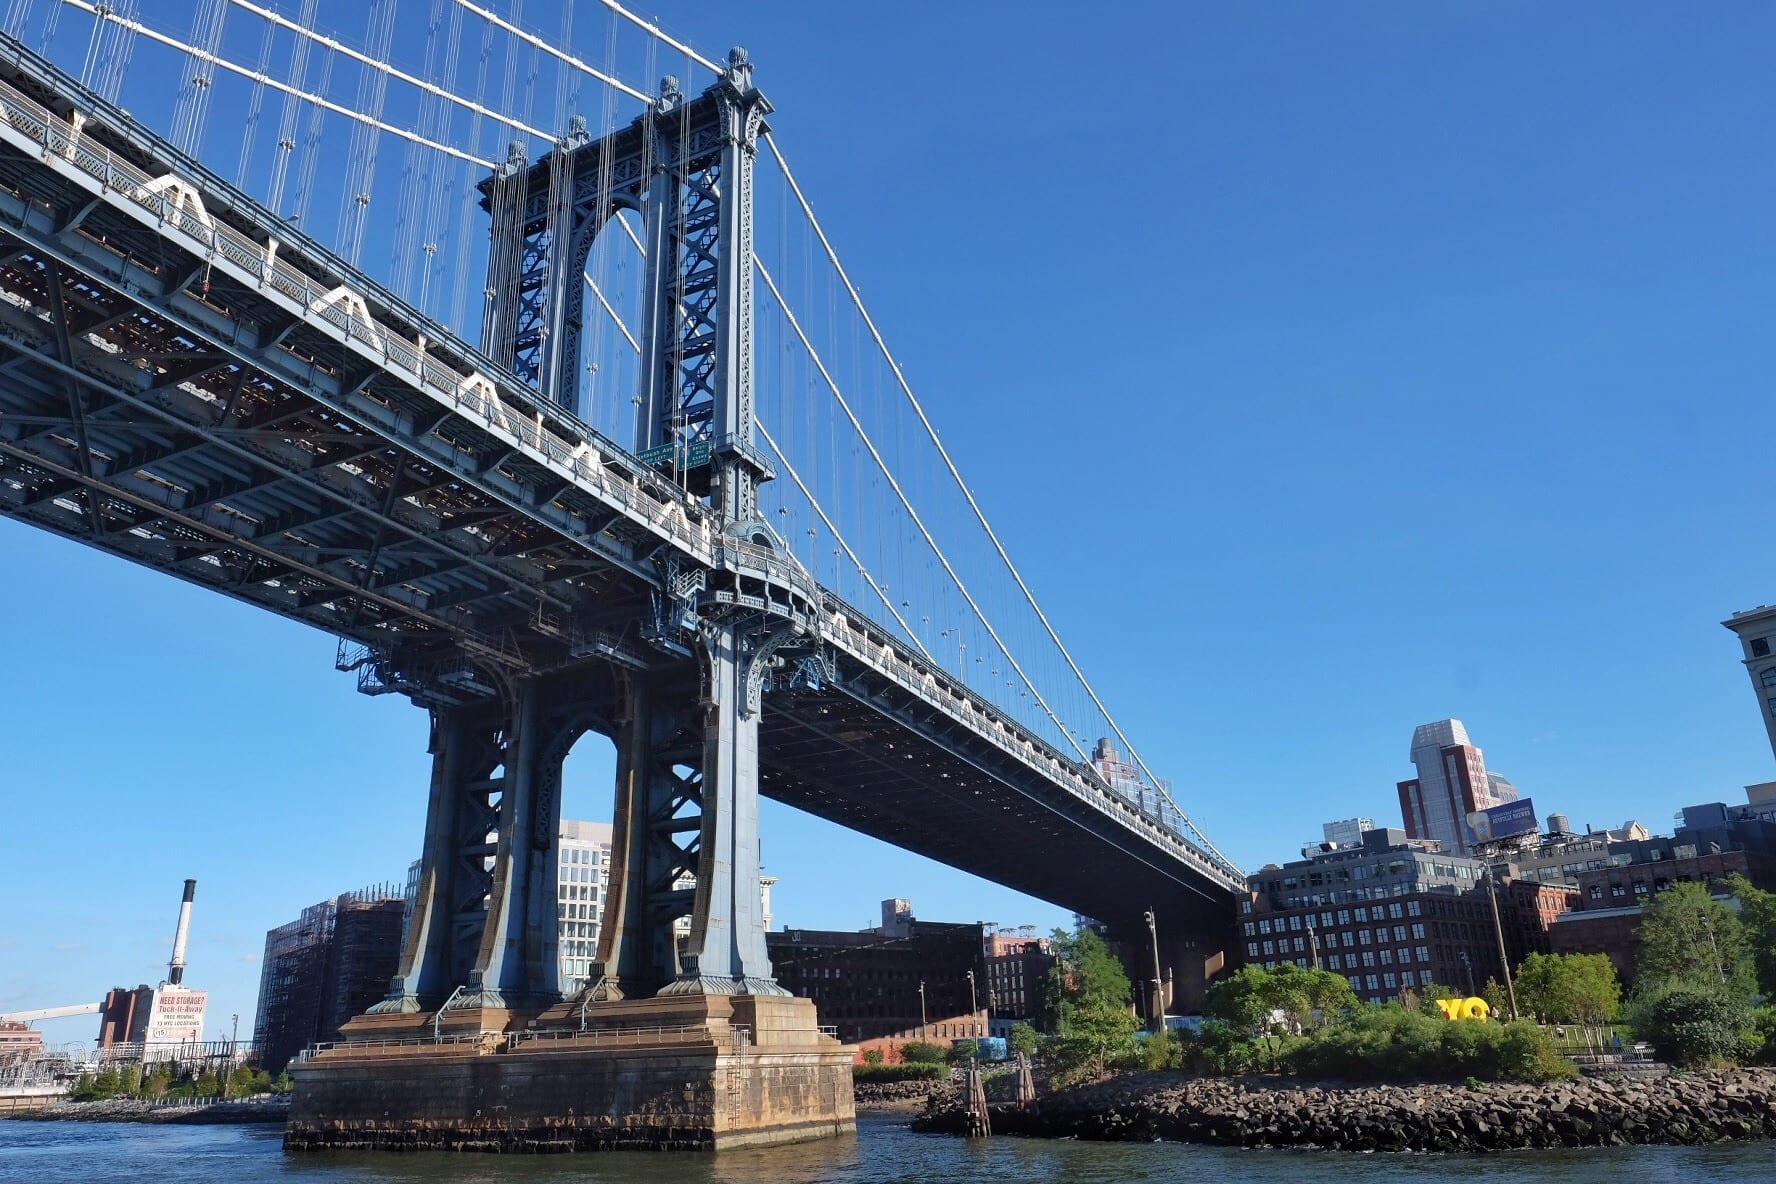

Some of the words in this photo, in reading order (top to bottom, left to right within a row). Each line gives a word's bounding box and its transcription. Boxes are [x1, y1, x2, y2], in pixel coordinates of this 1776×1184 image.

[160, 996, 175, 1004] NEED
[176, 996, 204, 1004] STORAGE?
[1436, 996, 1490, 1021] YO
